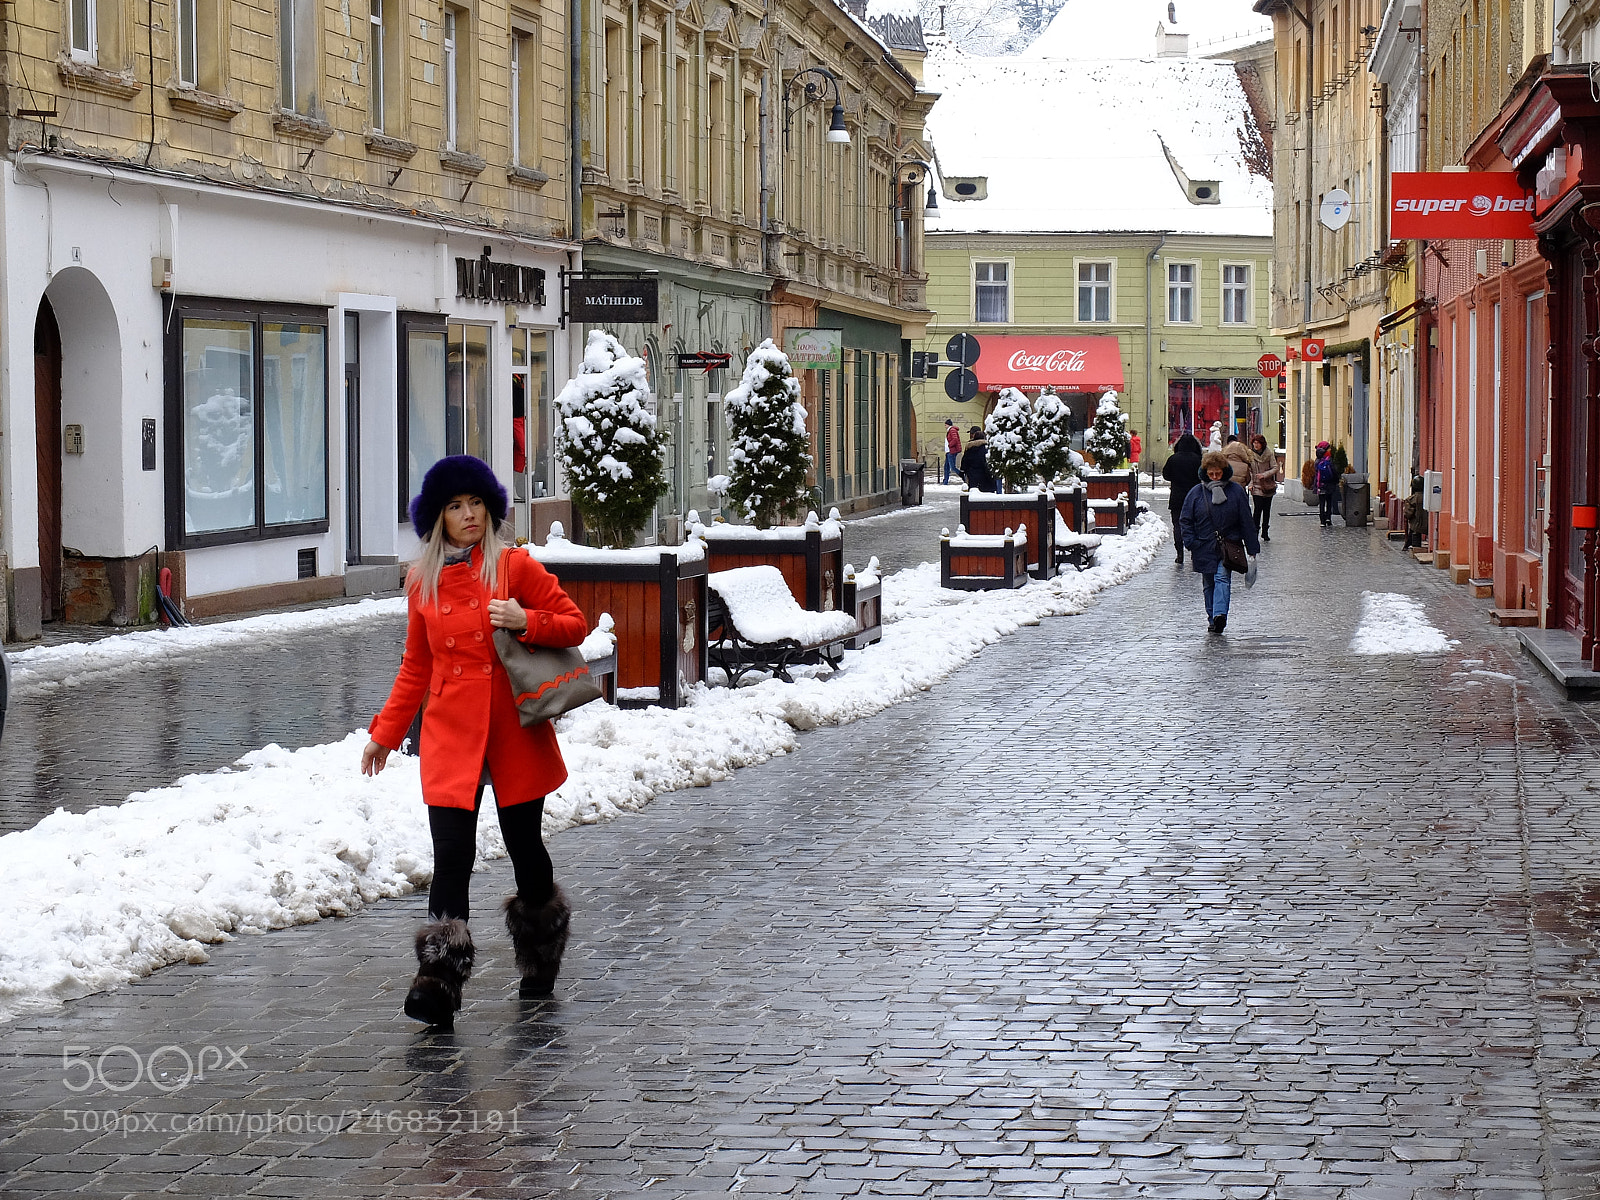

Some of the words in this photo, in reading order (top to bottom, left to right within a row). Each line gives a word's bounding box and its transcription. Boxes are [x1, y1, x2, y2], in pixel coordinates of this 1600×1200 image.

[1394, 199, 1467, 215] super
[1493, 195, 1535, 212] bet
[585, 294, 643, 306] MATHILDE
[1007, 349, 1089, 372] Coca-Cola
[1258, 360, 1281, 371] STOP
